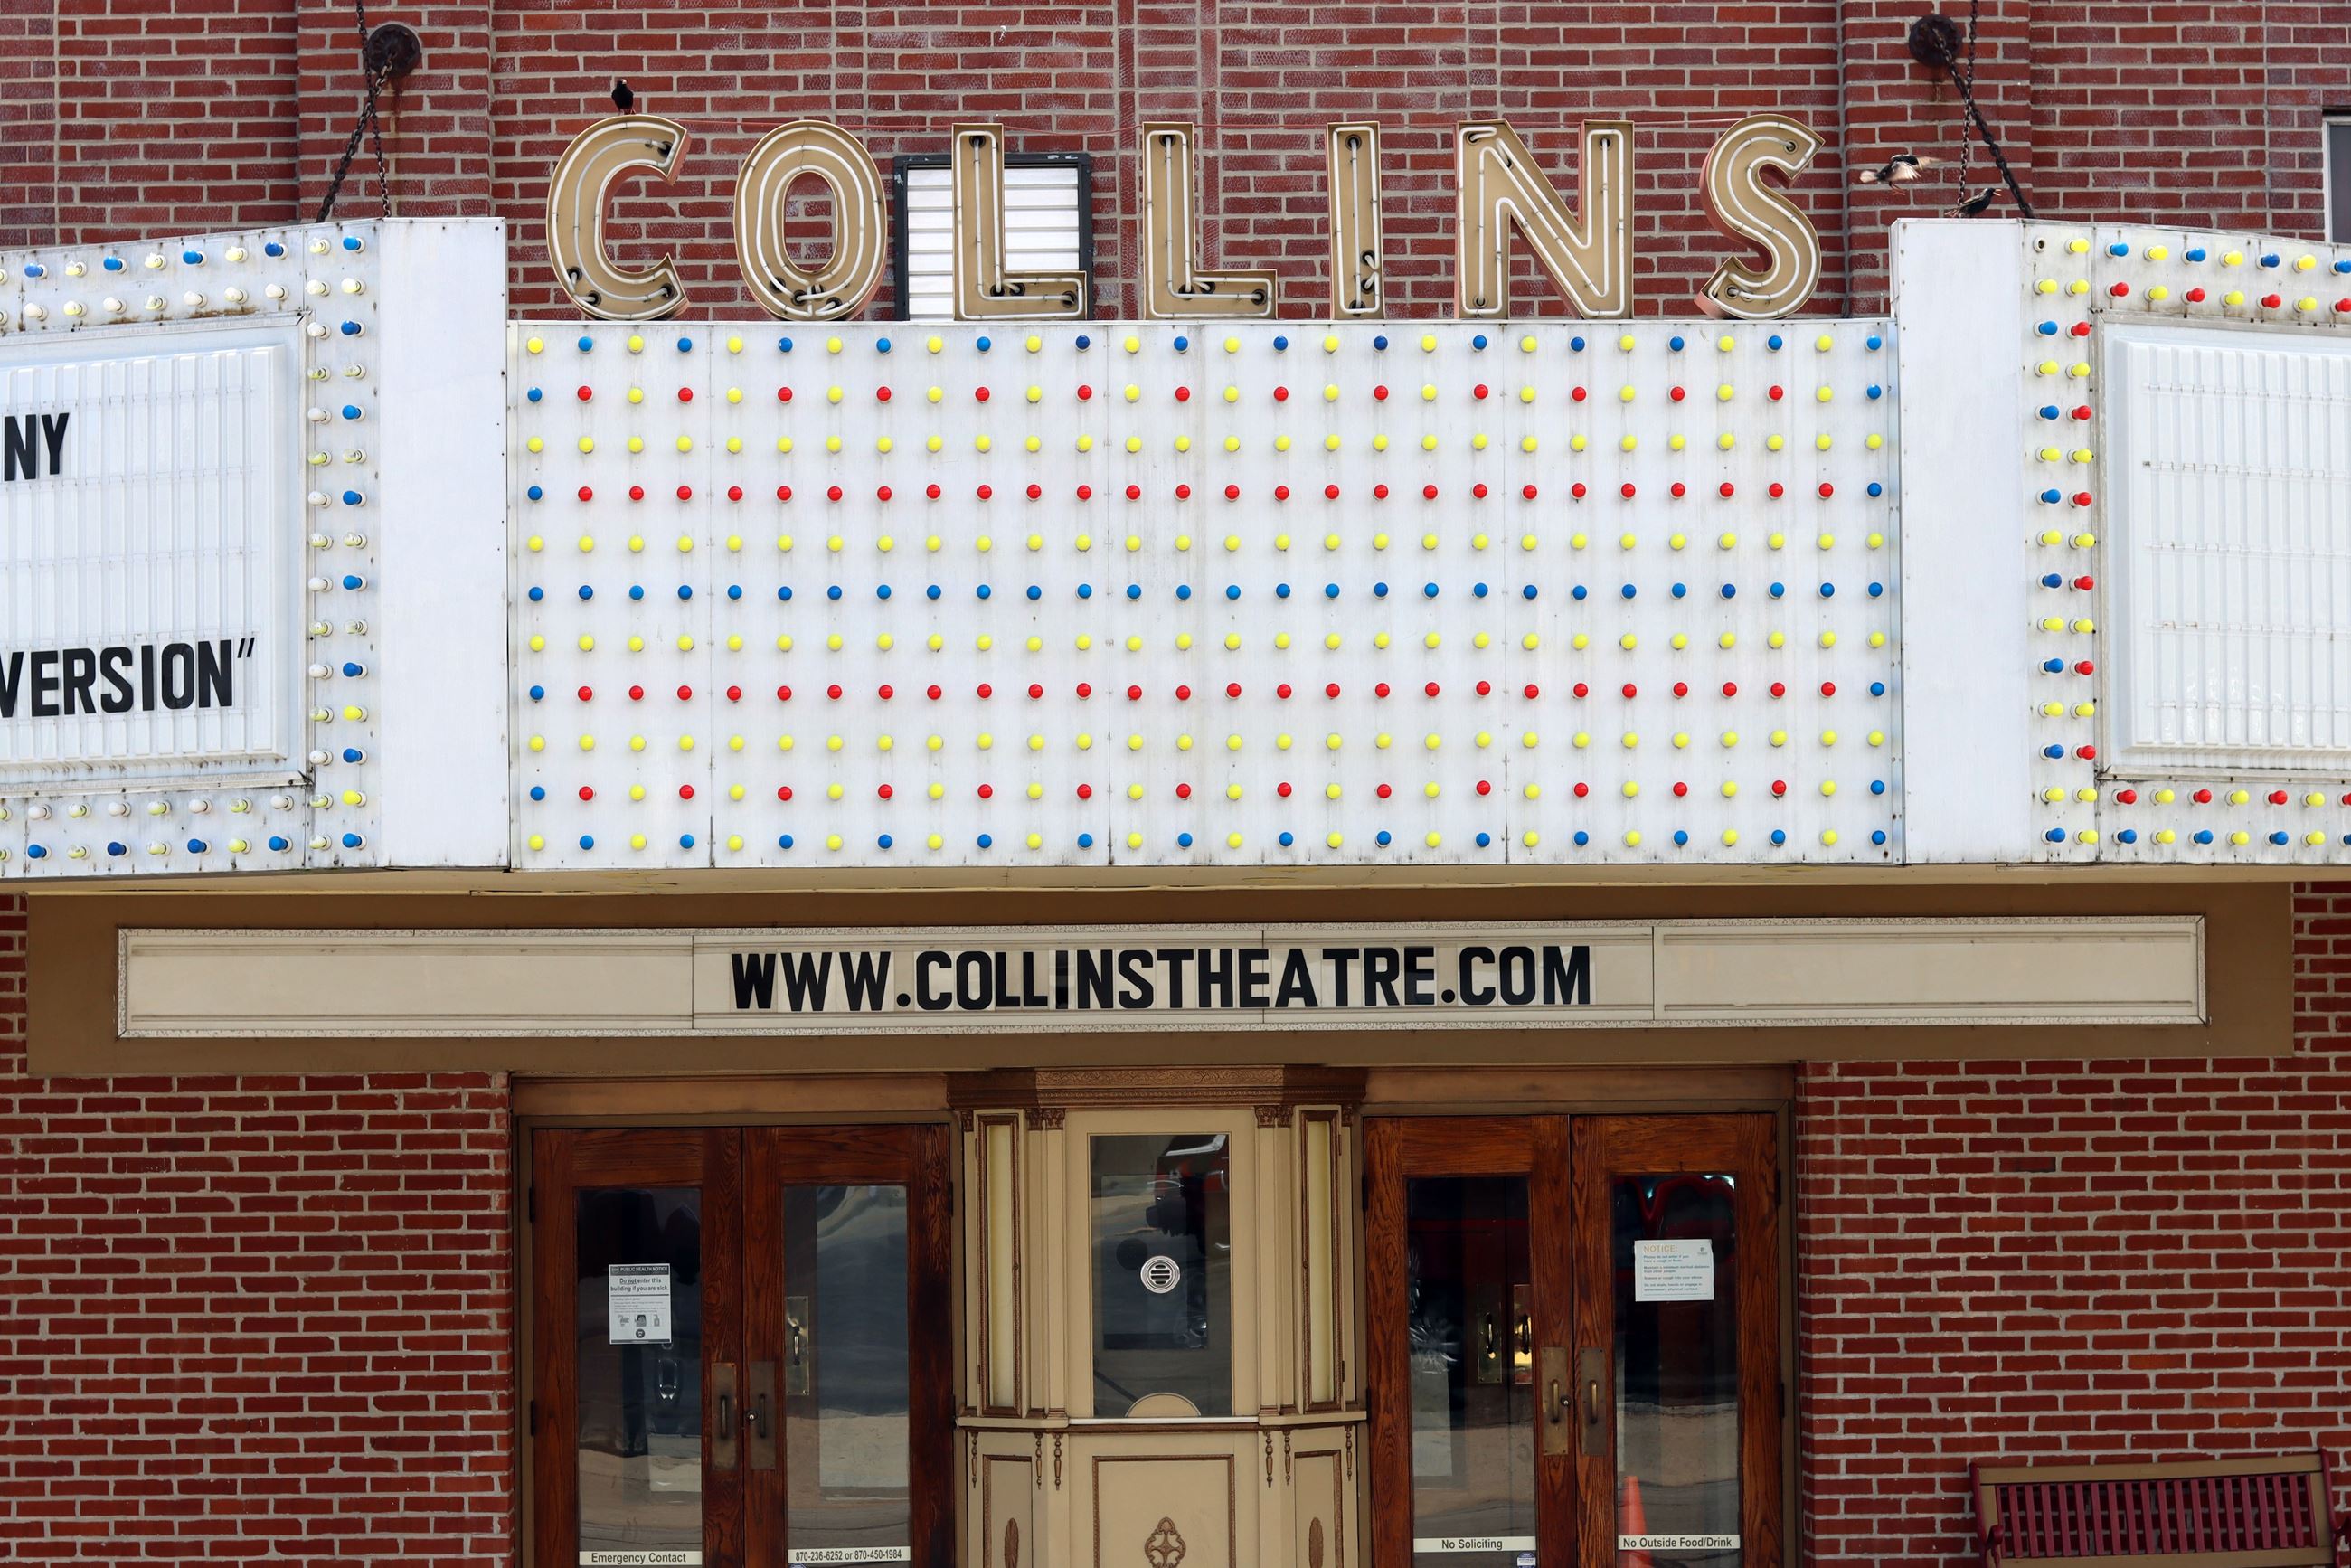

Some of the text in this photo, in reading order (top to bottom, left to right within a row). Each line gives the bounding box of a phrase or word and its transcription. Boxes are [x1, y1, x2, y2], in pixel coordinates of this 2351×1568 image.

[547, 114, 1825, 321] COLLINS
[4, 412, 70, 481] NY
[732, 945, 1591, 1012] WWW.COLLINSTHEATRE.COM
[1441, 1539, 1503, 1550] No Soliciting
[1623, 1537, 1732, 1547] No Outside Food/Drink
[591, 1553, 686, 1564] Emergency Contact
[796, 1551, 843, 1561] 870-236-6252
[854, 1549, 902, 1560] 870-450-1984
